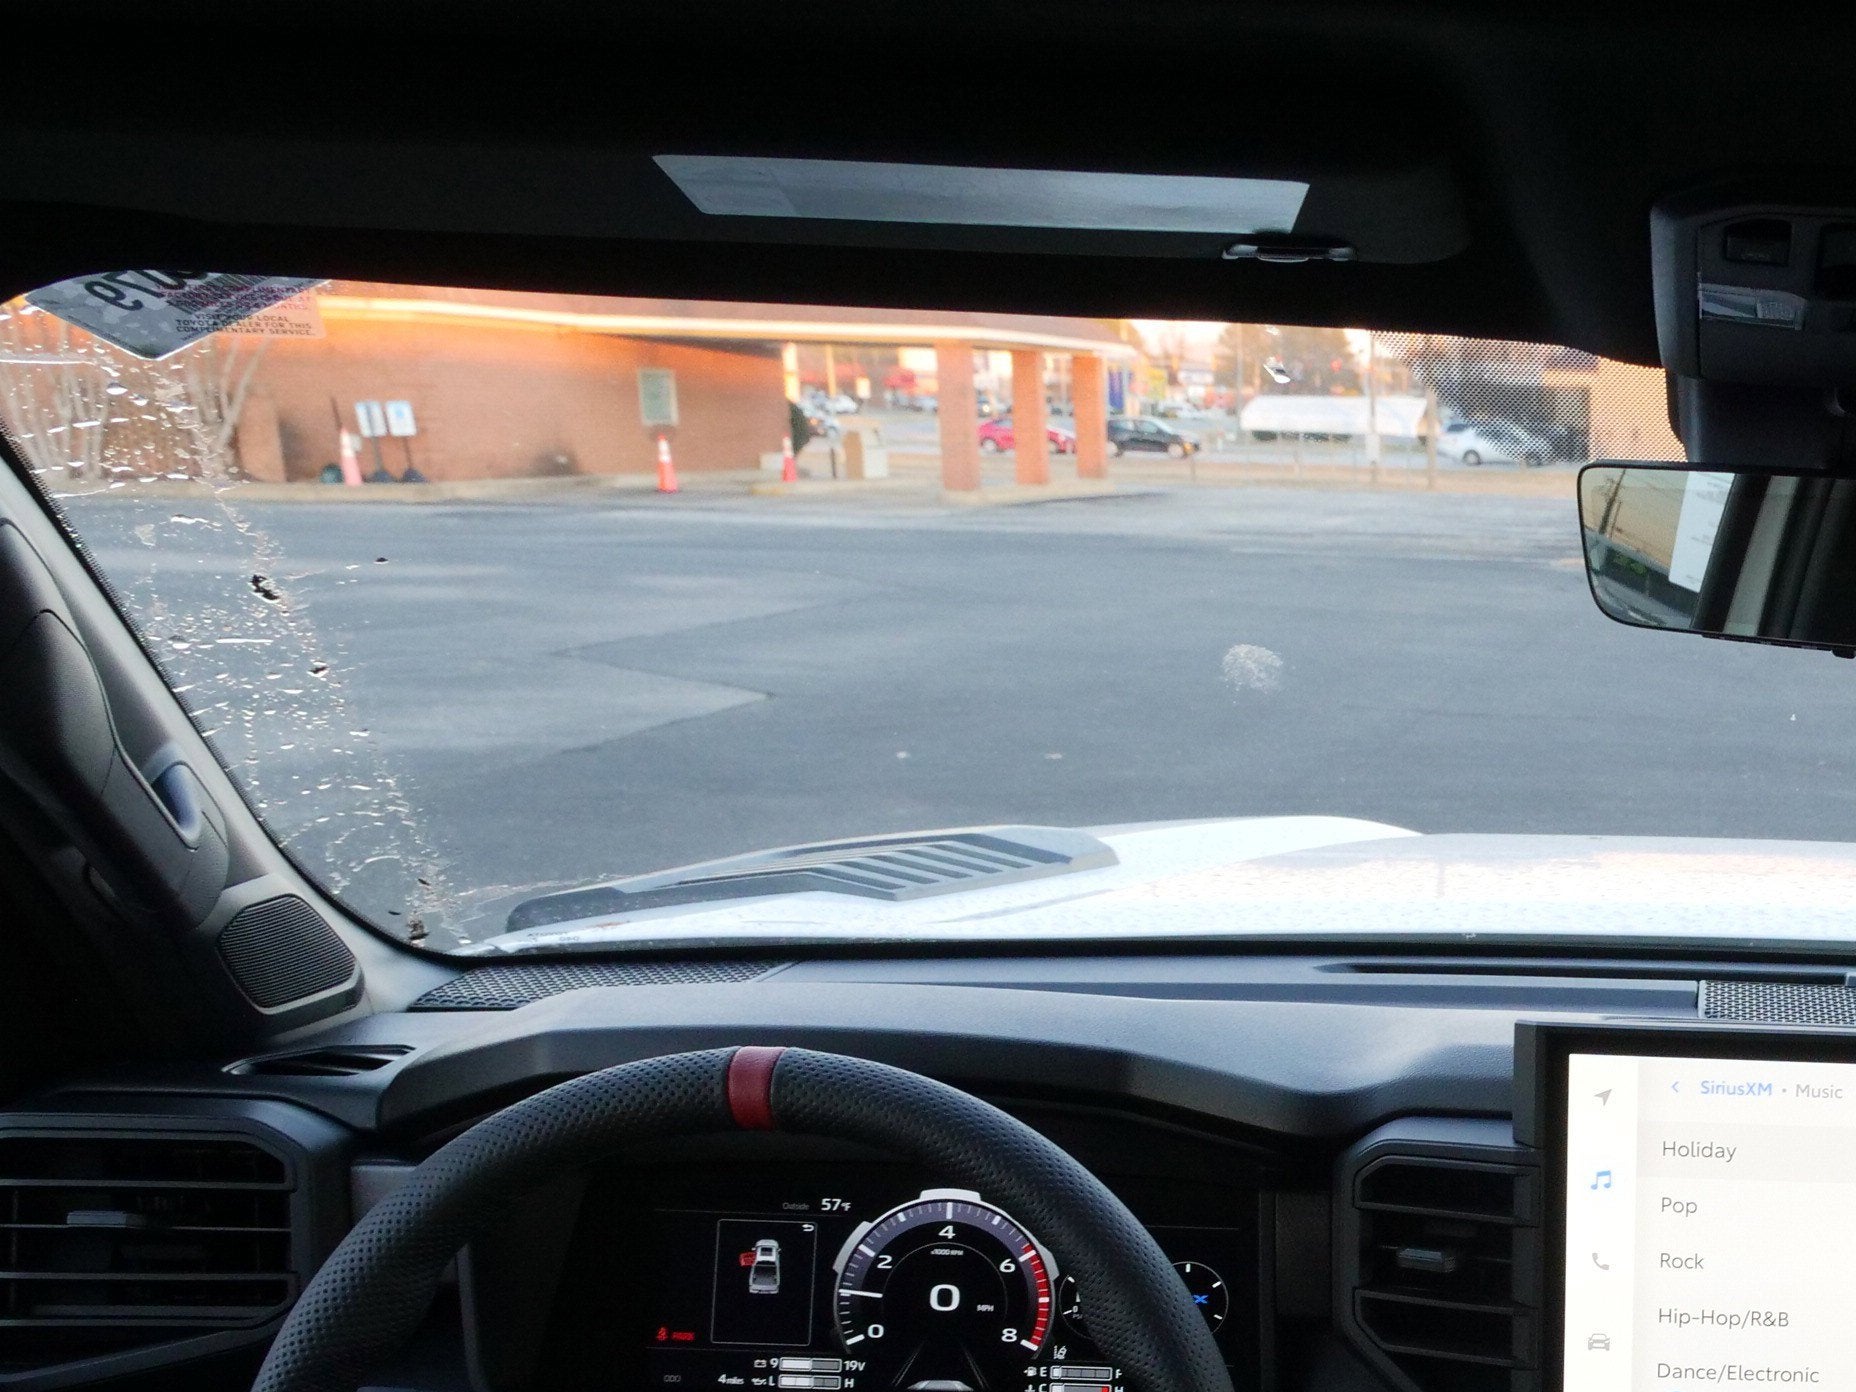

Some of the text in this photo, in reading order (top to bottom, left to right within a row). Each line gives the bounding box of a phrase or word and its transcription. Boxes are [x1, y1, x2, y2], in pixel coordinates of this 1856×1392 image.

[175, 318, 218, 327] TOYOTA
[265, 321, 286, 329] FOR
[289, 322, 312, 330] THIS
[256, 315, 289, 323] LOCAL
[1700, 1080, 1843, 1100] SiriusXM Music
[1662, 1140, 1738, 1163] Holiday
[1660, 1196, 1699, 1219] Pop
[938, 1224, 956, 1240] 4
[876, 1255, 893, 1270] 2
[999, 1258, 1016, 1274] 6
[1659, 1252, 1705, 1270] Rock
[929, 1283, 961, 1312] 0
[1657, 1307, 1790, 1330] Hip-Hop/R&B
[866, 1323, 885, 1339] 0
[1001, 1327, 1018, 1343] 8
[769, 1357, 779, 1369] 9
[843, 1360, 867, 1372] 19V
[1040, 1366, 1048, 1377] E
[1656, 1362, 1820, 1384] Dance/Electronic
[768, 1375, 776, 1386] L
[843, 1377, 855, 1388] H
